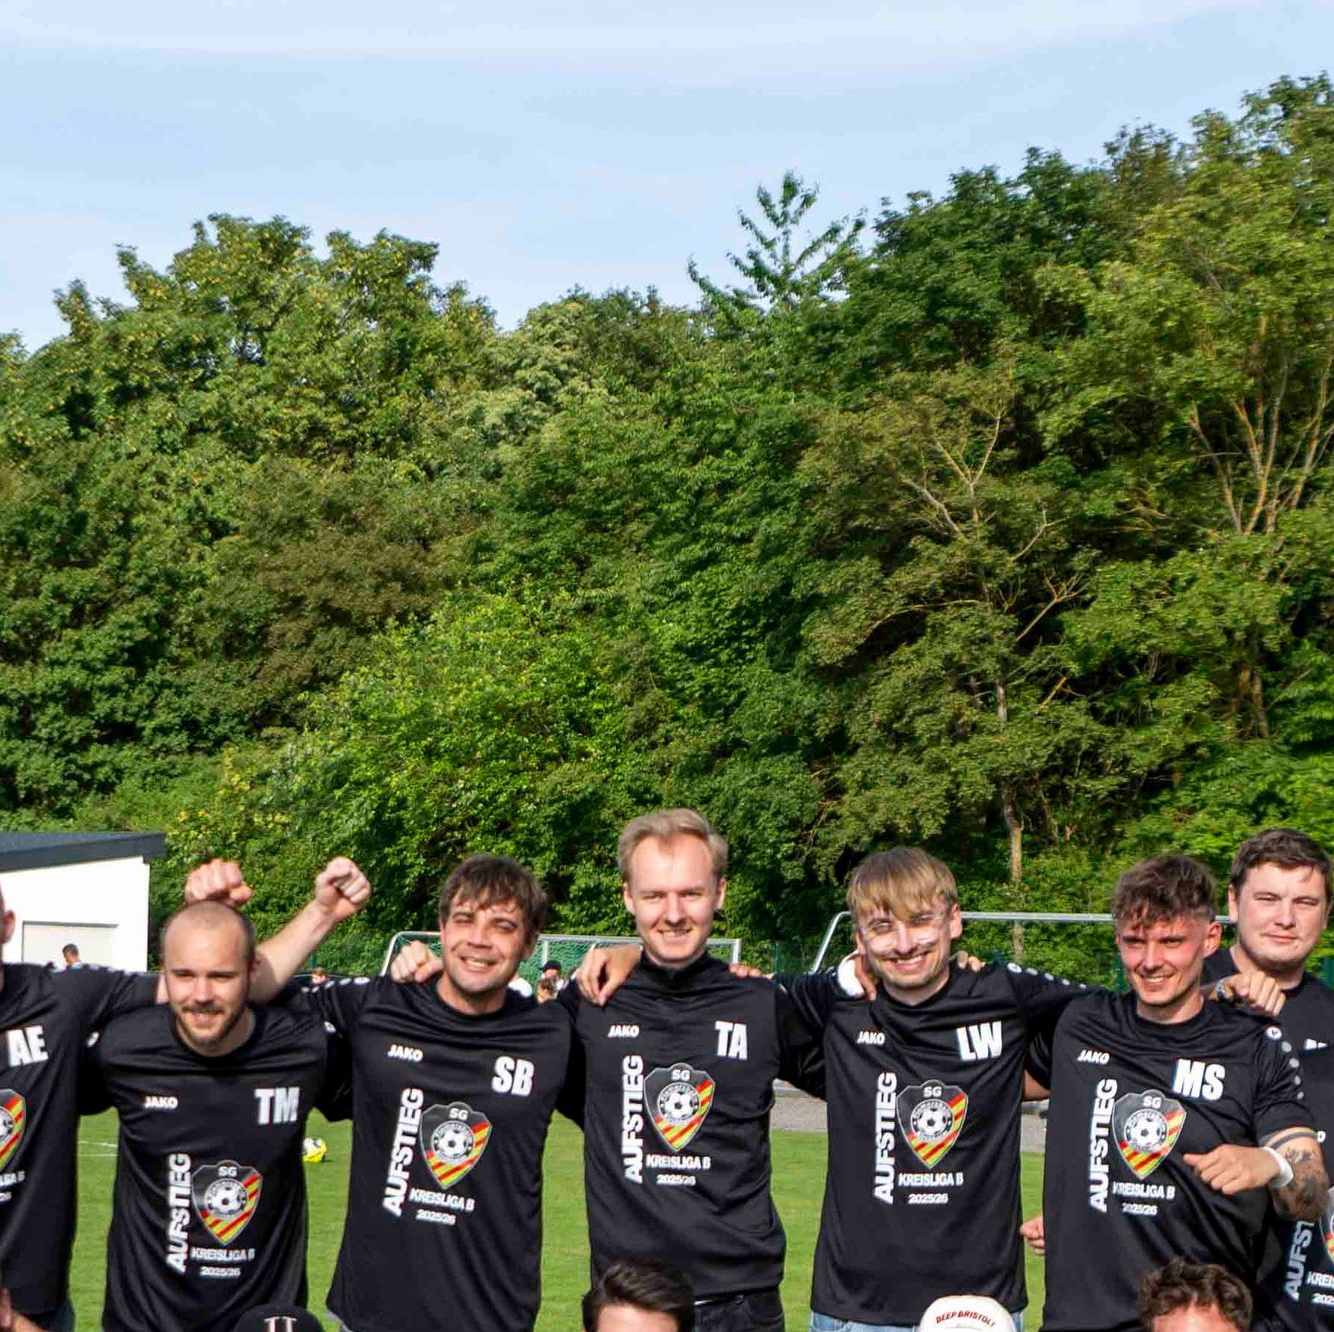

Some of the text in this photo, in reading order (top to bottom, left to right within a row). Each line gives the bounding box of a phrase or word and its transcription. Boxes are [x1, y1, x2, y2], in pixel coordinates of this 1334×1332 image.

[607, 1024, 640, 1038] JAKO
[715, 1020, 748, 1060] TA
[856, 1031, 886, 1046] JAKO
[956, 1020, 1003, 1062] LW
[6, 1025, 49, 1068] AE
[387, 1044, 424, 1063] JAKO
[1077, 1049, 1110, 1065] JAKO
[491, 1055, 535, 1097] SB
[671, 1070, 691, 1082] SG
[1172, 1058, 1226, 1101] MS
[144, 1095, 179, 1110] JAKO
[923, 1086, 942, 1098] SG
[1143, 1095, 1162, 1109] SG
[254, 1087, 300, 1125] TM
[449, 1107, 468, 1121] SG
[621, 1054, 644, 1184] AUFSTIEG
[873, 1072, 897, 1205] AUFSTIEG
[1090, 1078, 1118, 1214] AUFSTIEG
[382, 1088, 425, 1218] AUFSTIEG
[645, 1155, 711, 1170] KREISLIGA B
[218, 1166, 237, 1177] SG
[898, 1172, 964, 1188] KREISLIGA B
[408, 1187, 464, 1211] KREISLIGA
[1166, 1186, 1176, 1200] B
[166, 1153, 192, 1274] AUFSTIEG
[1284, 1220, 1315, 1301] AUFST
